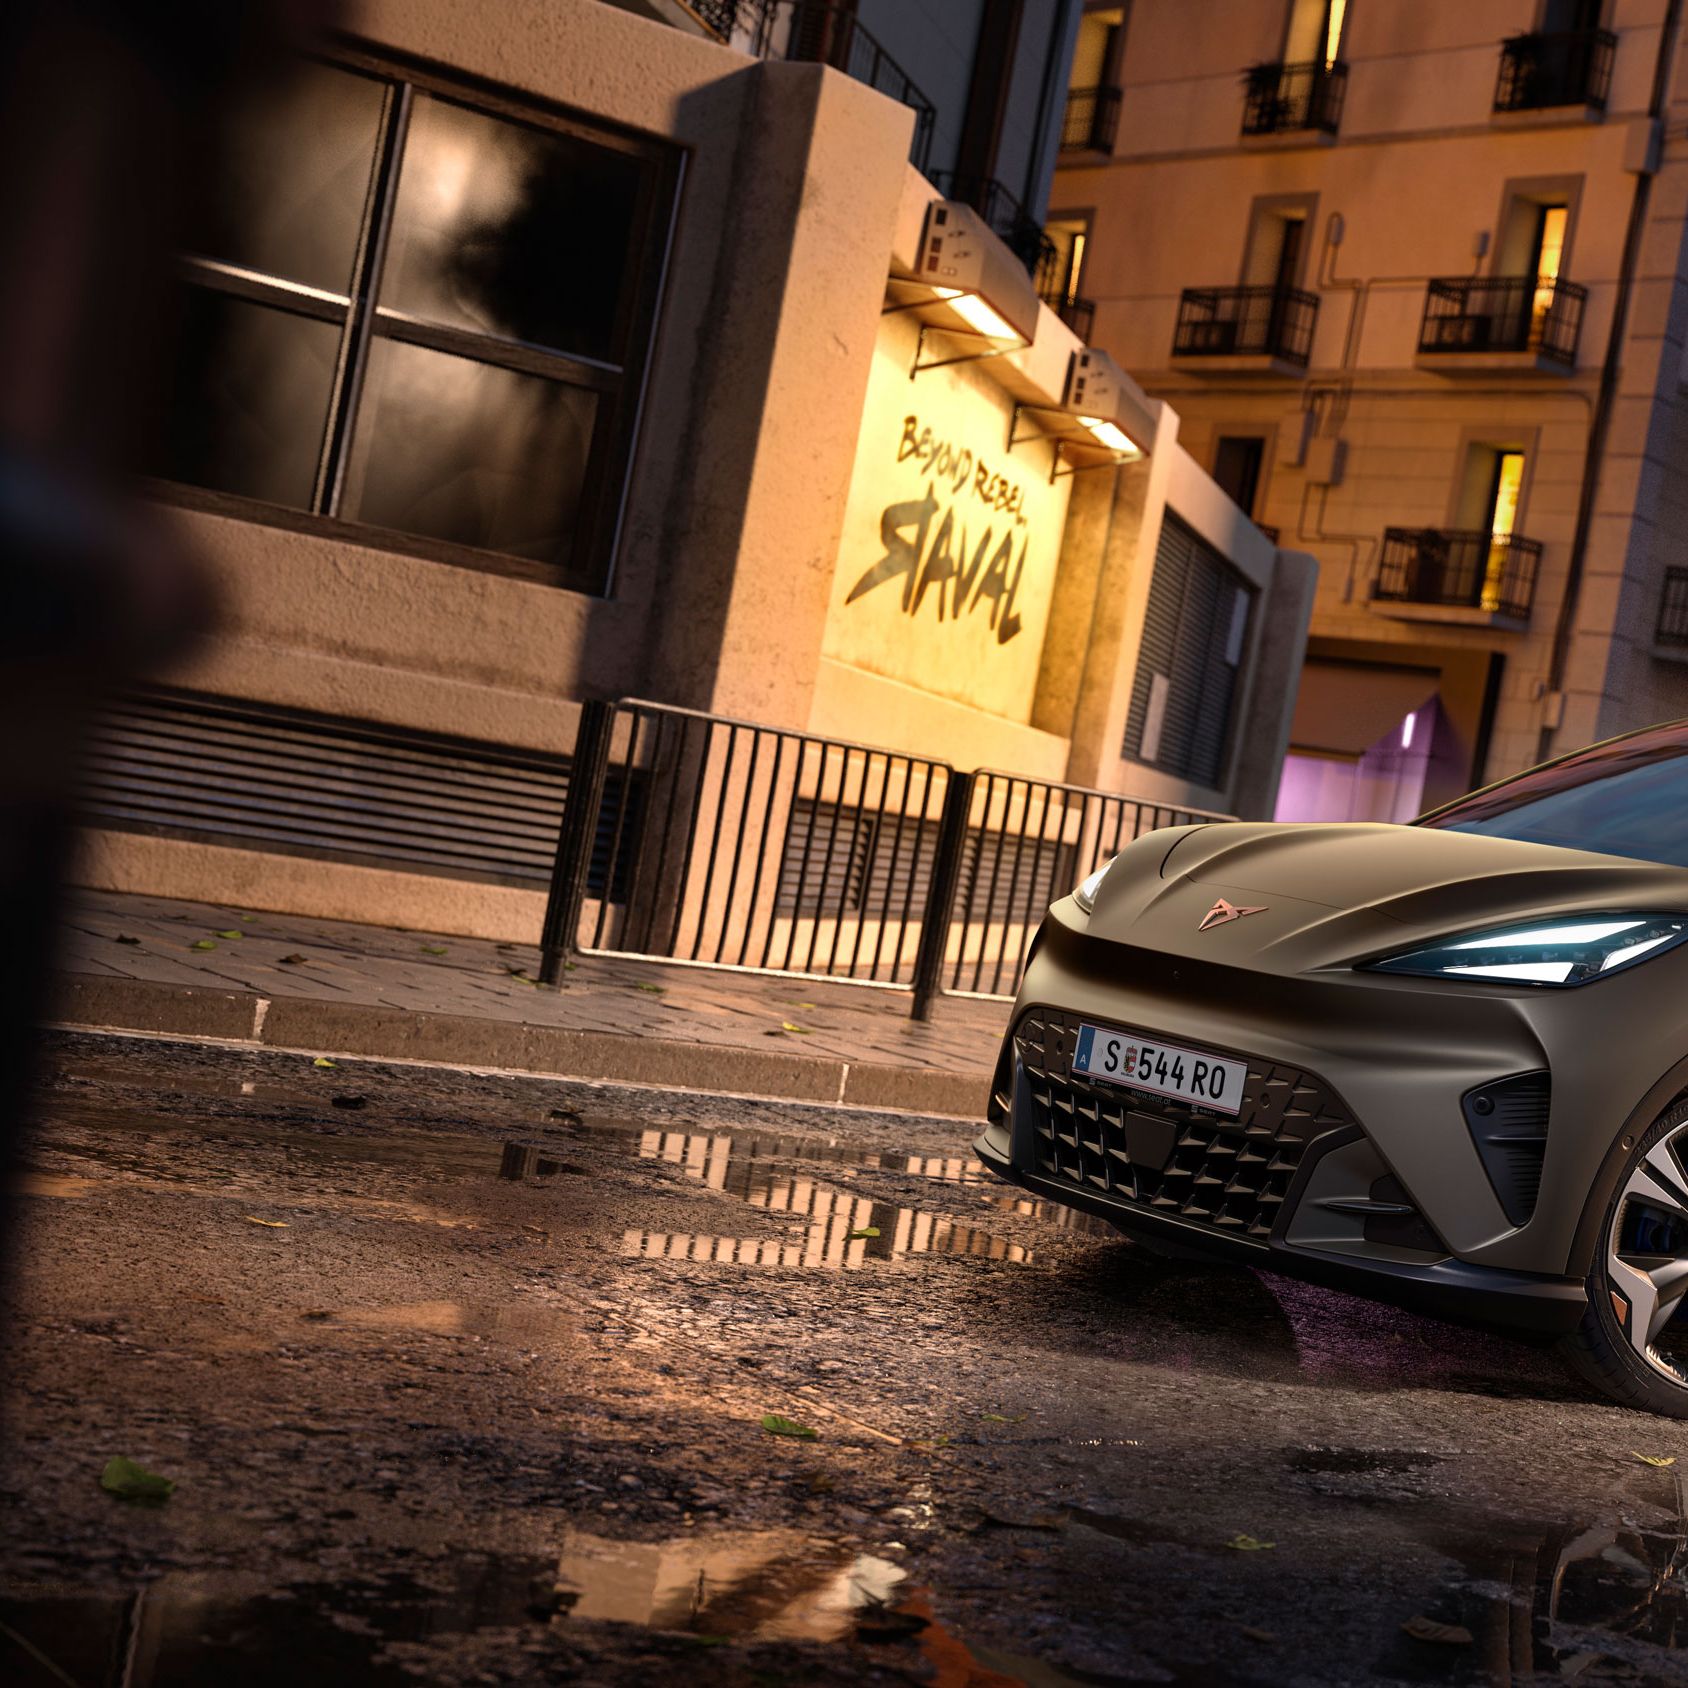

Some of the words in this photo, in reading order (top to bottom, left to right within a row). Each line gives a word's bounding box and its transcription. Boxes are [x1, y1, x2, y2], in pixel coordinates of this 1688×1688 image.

[897, 415, 972, 494] BEYOND
[973, 459, 1027, 527] REBEL
[1080, 1054, 1087, 1065] A
[1104, 1040, 1121, 1072] S
[1138, 1047, 1184, 1090] 544
[1190, 1060, 1226, 1099] RO
